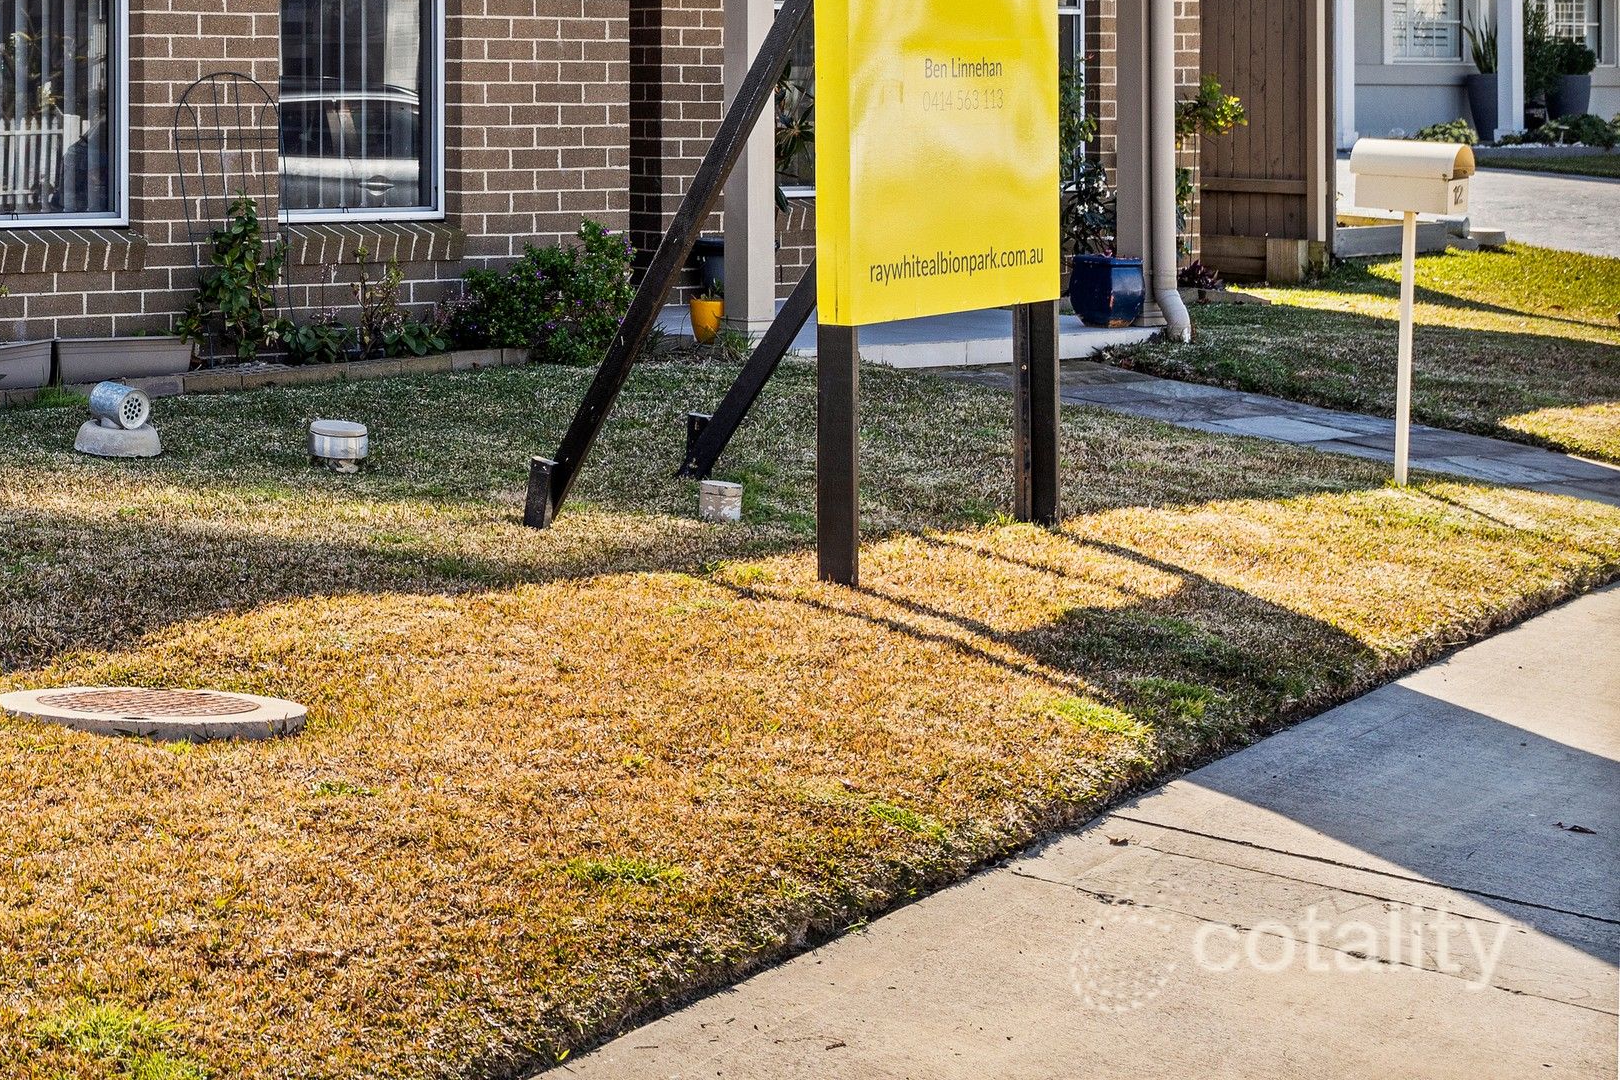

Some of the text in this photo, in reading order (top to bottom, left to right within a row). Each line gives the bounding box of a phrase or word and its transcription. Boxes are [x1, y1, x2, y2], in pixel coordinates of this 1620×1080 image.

[924, 56, 1002, 78] Ben Linnehan
[923, 88, 1004, 112] 0414 563 113
[870, 246, 1044, 286] raywhitealbionpark.com.au
